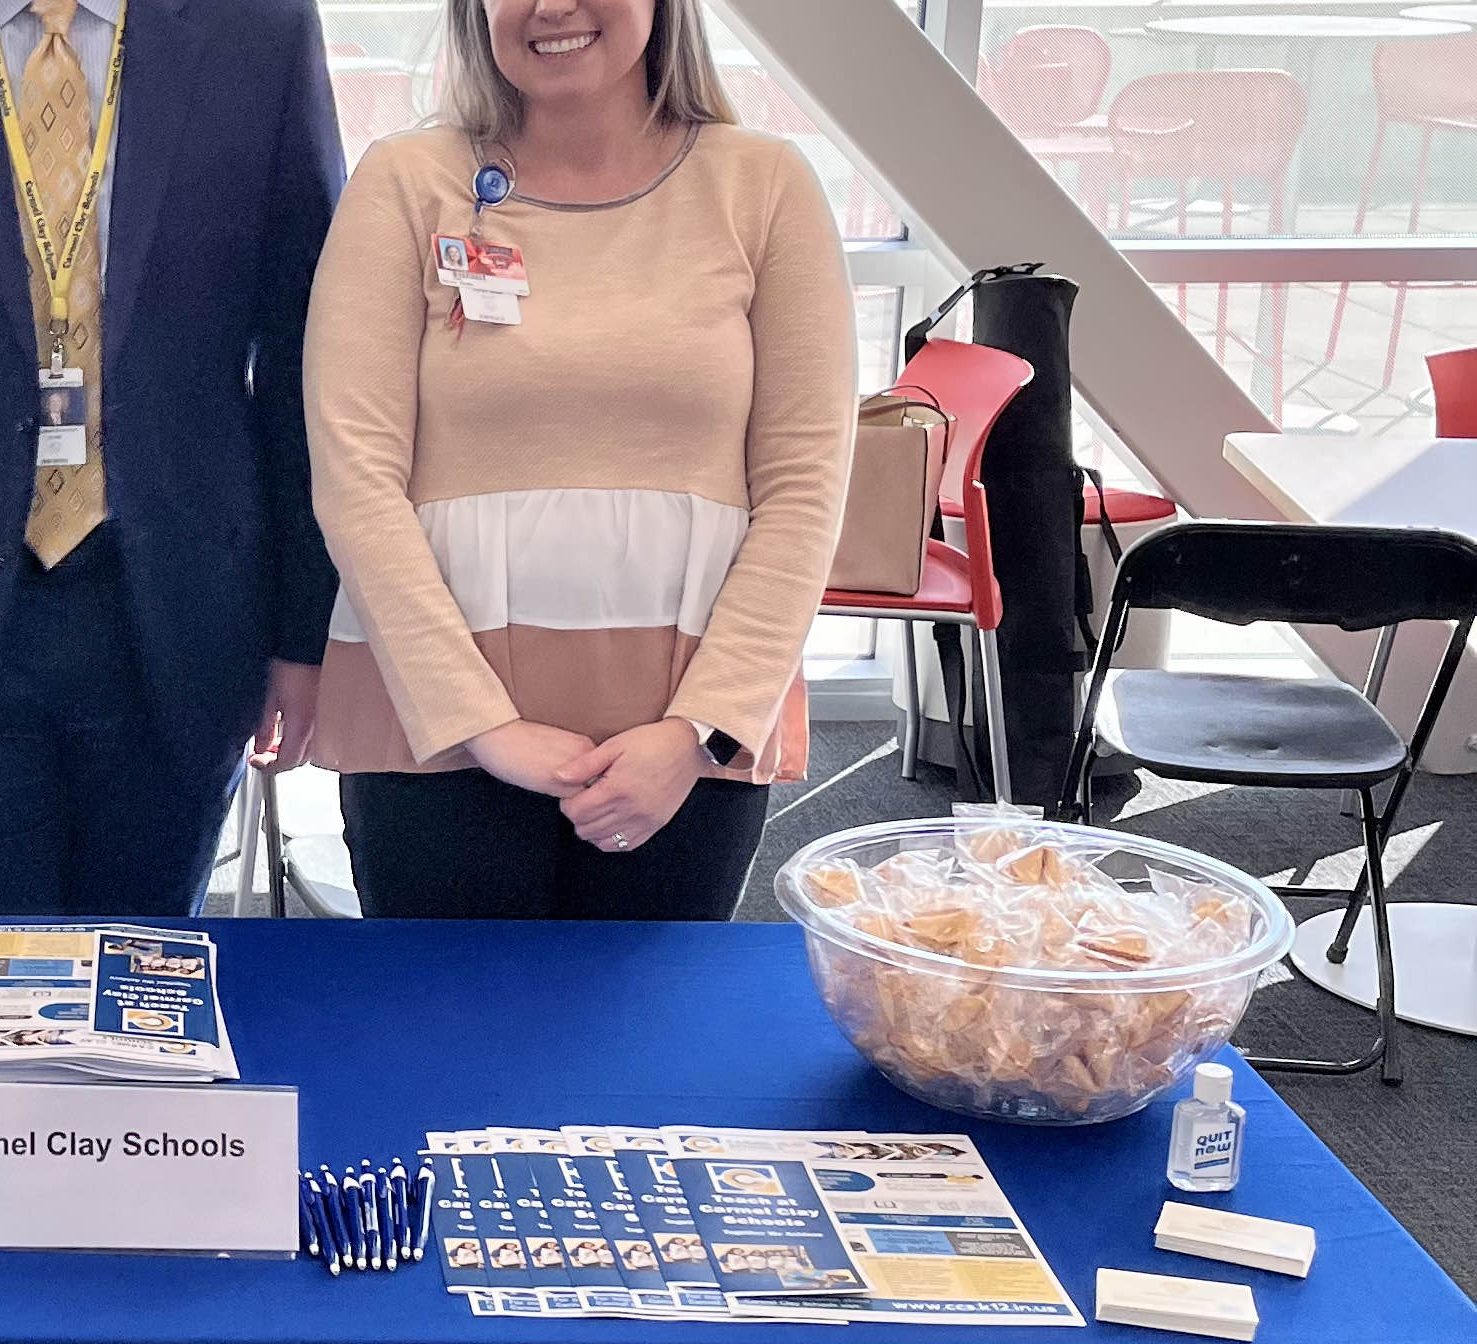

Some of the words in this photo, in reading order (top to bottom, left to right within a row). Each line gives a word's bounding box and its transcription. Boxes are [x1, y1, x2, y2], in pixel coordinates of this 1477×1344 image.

[1196, 1130, 1232, 1147] QUIT
[46, 1131, 112, 1163] Clay
[123, 1132, 245, 1158] Schools
[711, 1194, 772, 1206] Teach
[776, 1197, 799, 1207] at
[699, 1204, 772, 1217] Carmel
[776, 1207, 820, 1219] Clay
[722, 1216, 806, 1227] Schools
